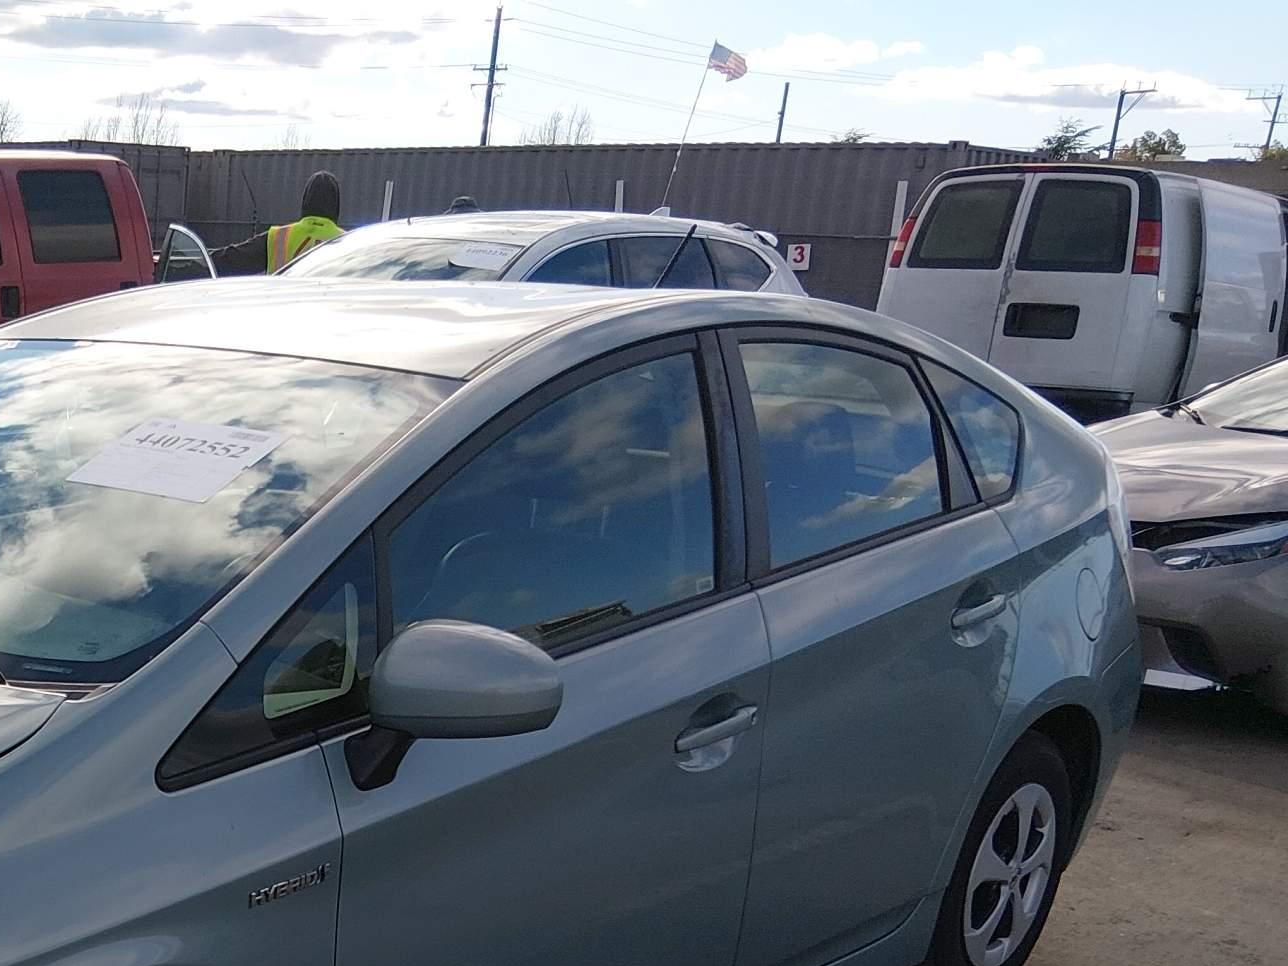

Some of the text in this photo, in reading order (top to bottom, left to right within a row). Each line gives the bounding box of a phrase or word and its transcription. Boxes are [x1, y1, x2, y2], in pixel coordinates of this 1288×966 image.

[792, 245, 805, 264] 3
[135, 432, 250, 458] 44072552
[248, 871, 319, 909] HYBRID
